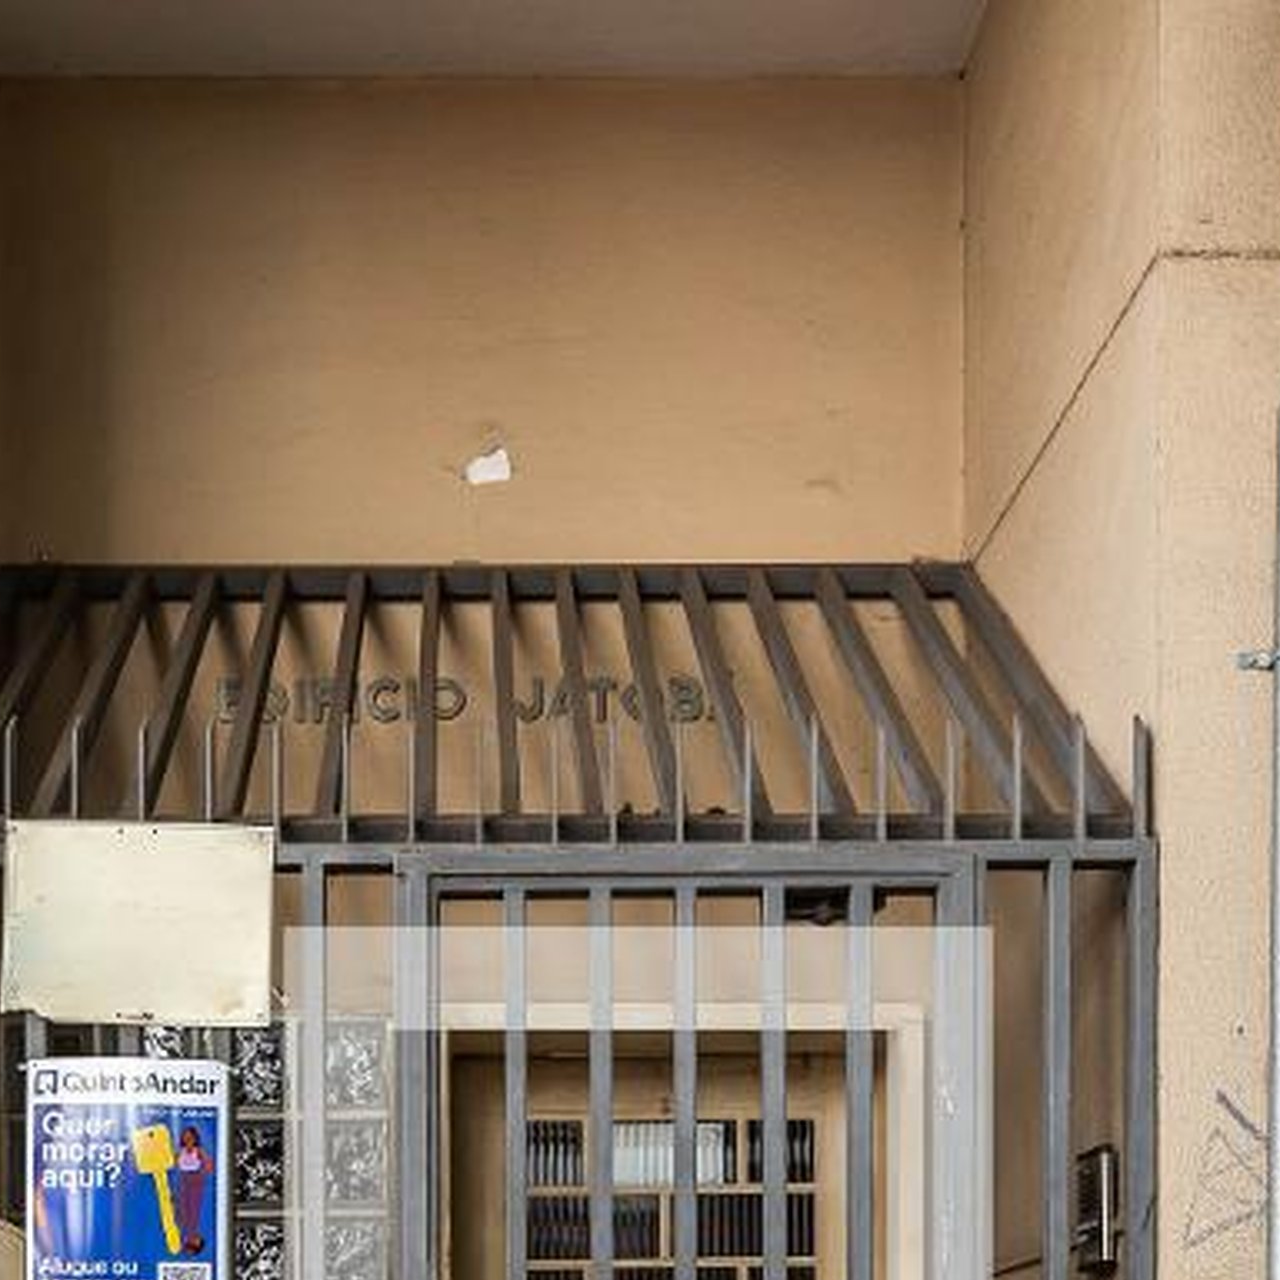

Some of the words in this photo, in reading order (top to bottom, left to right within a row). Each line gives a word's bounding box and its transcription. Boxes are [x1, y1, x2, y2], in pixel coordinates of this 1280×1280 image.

[42, 1142, 130, 1162] morar
[41, 1163, 121, 1192] aqui?
[112, 1261, 138, 1275] ou
